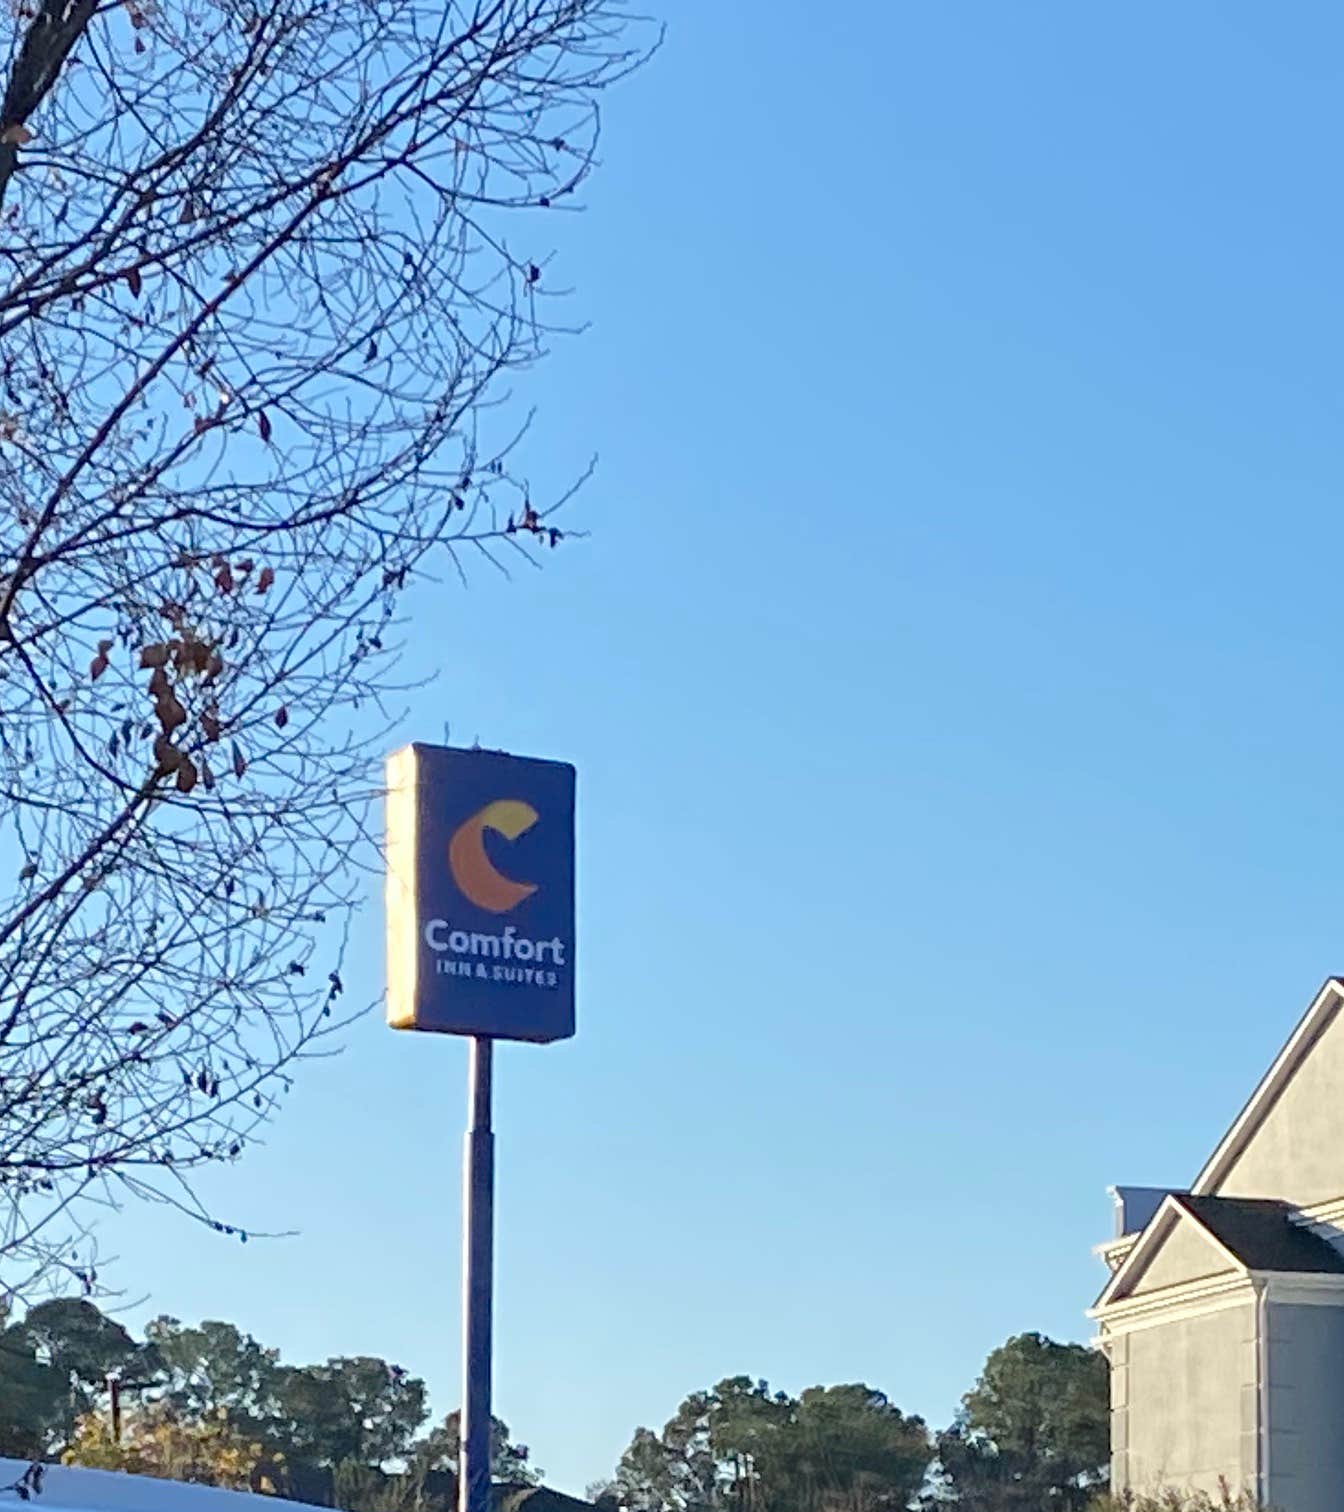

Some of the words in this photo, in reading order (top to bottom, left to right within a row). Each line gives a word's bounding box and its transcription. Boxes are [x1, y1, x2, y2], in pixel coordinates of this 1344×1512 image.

[424, 918, 566, 966] Comfort
[436, 959, 472, 977] INN
[492, 965, 558, 987] SUITES
